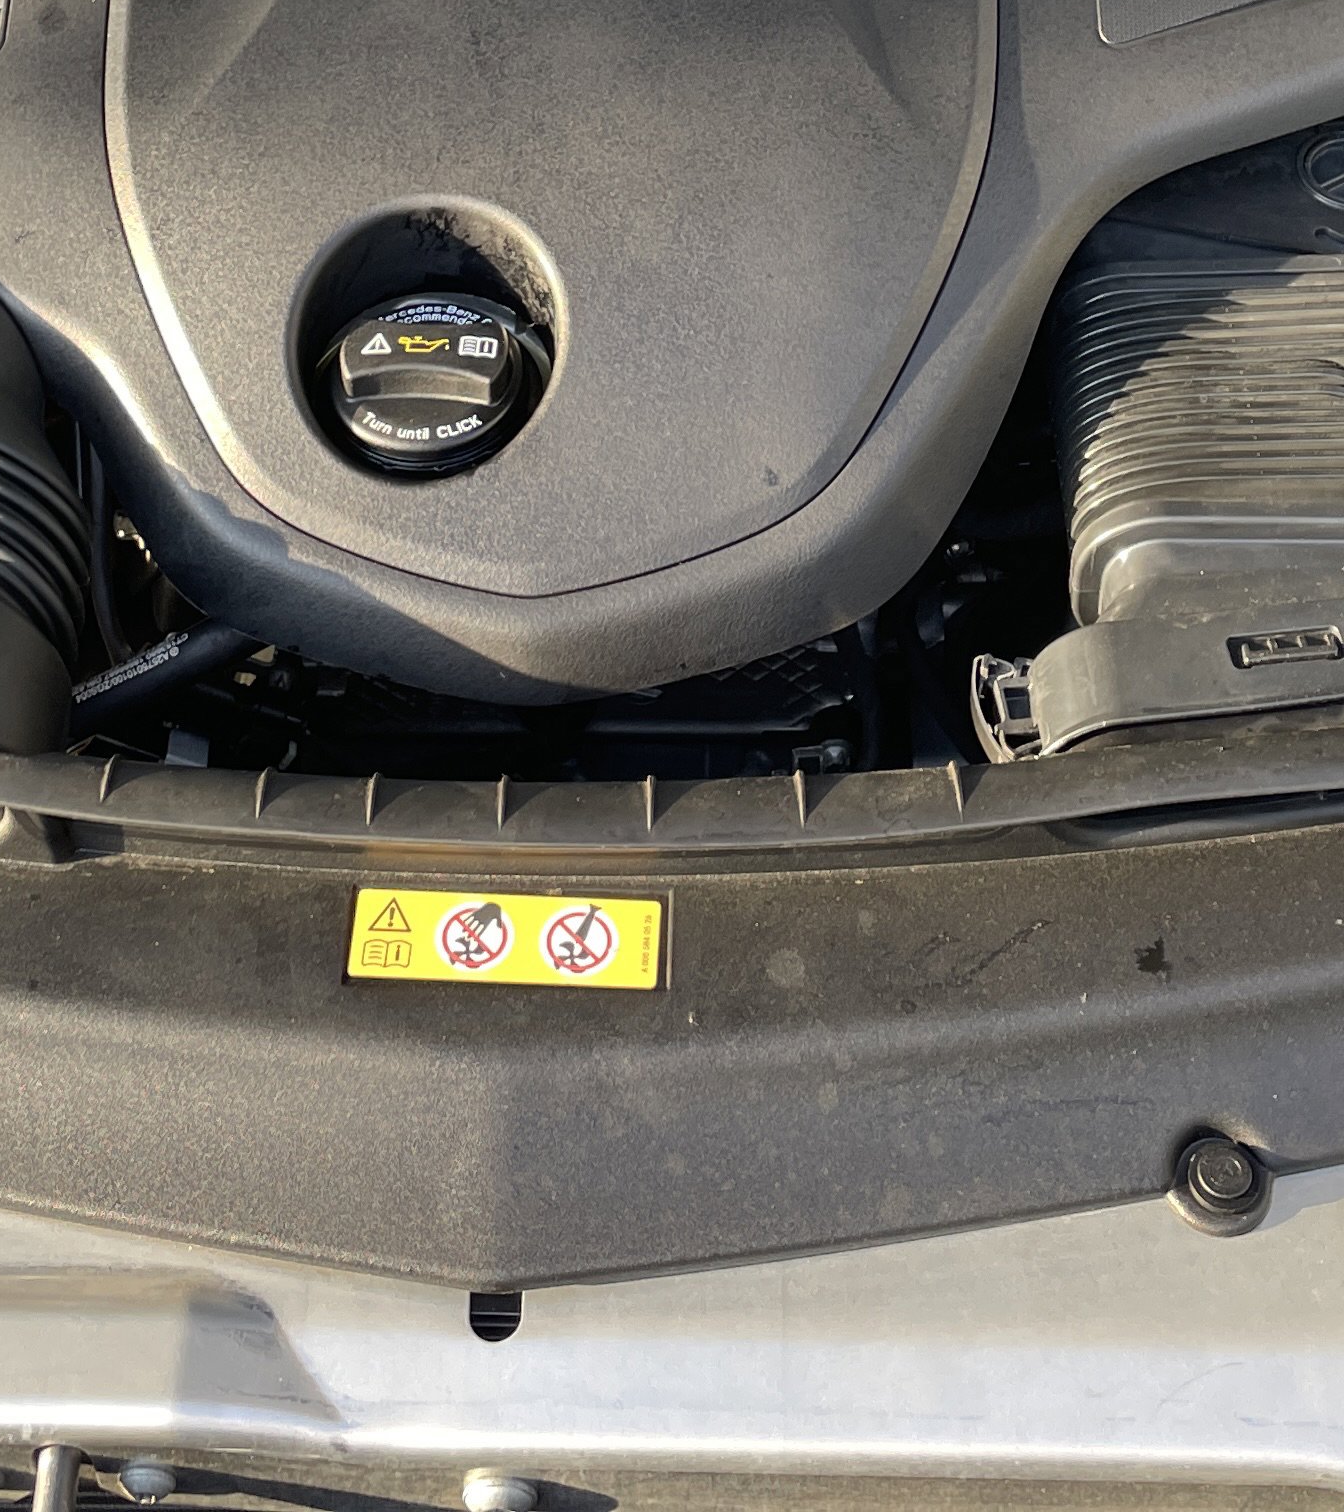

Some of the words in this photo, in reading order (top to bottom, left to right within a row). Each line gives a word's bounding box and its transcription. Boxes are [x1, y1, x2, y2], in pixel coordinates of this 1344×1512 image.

[361, 410, 394, 435] Turn
[396, 426, 431, 440] until
[435, 413, 484, 440] CLICK
